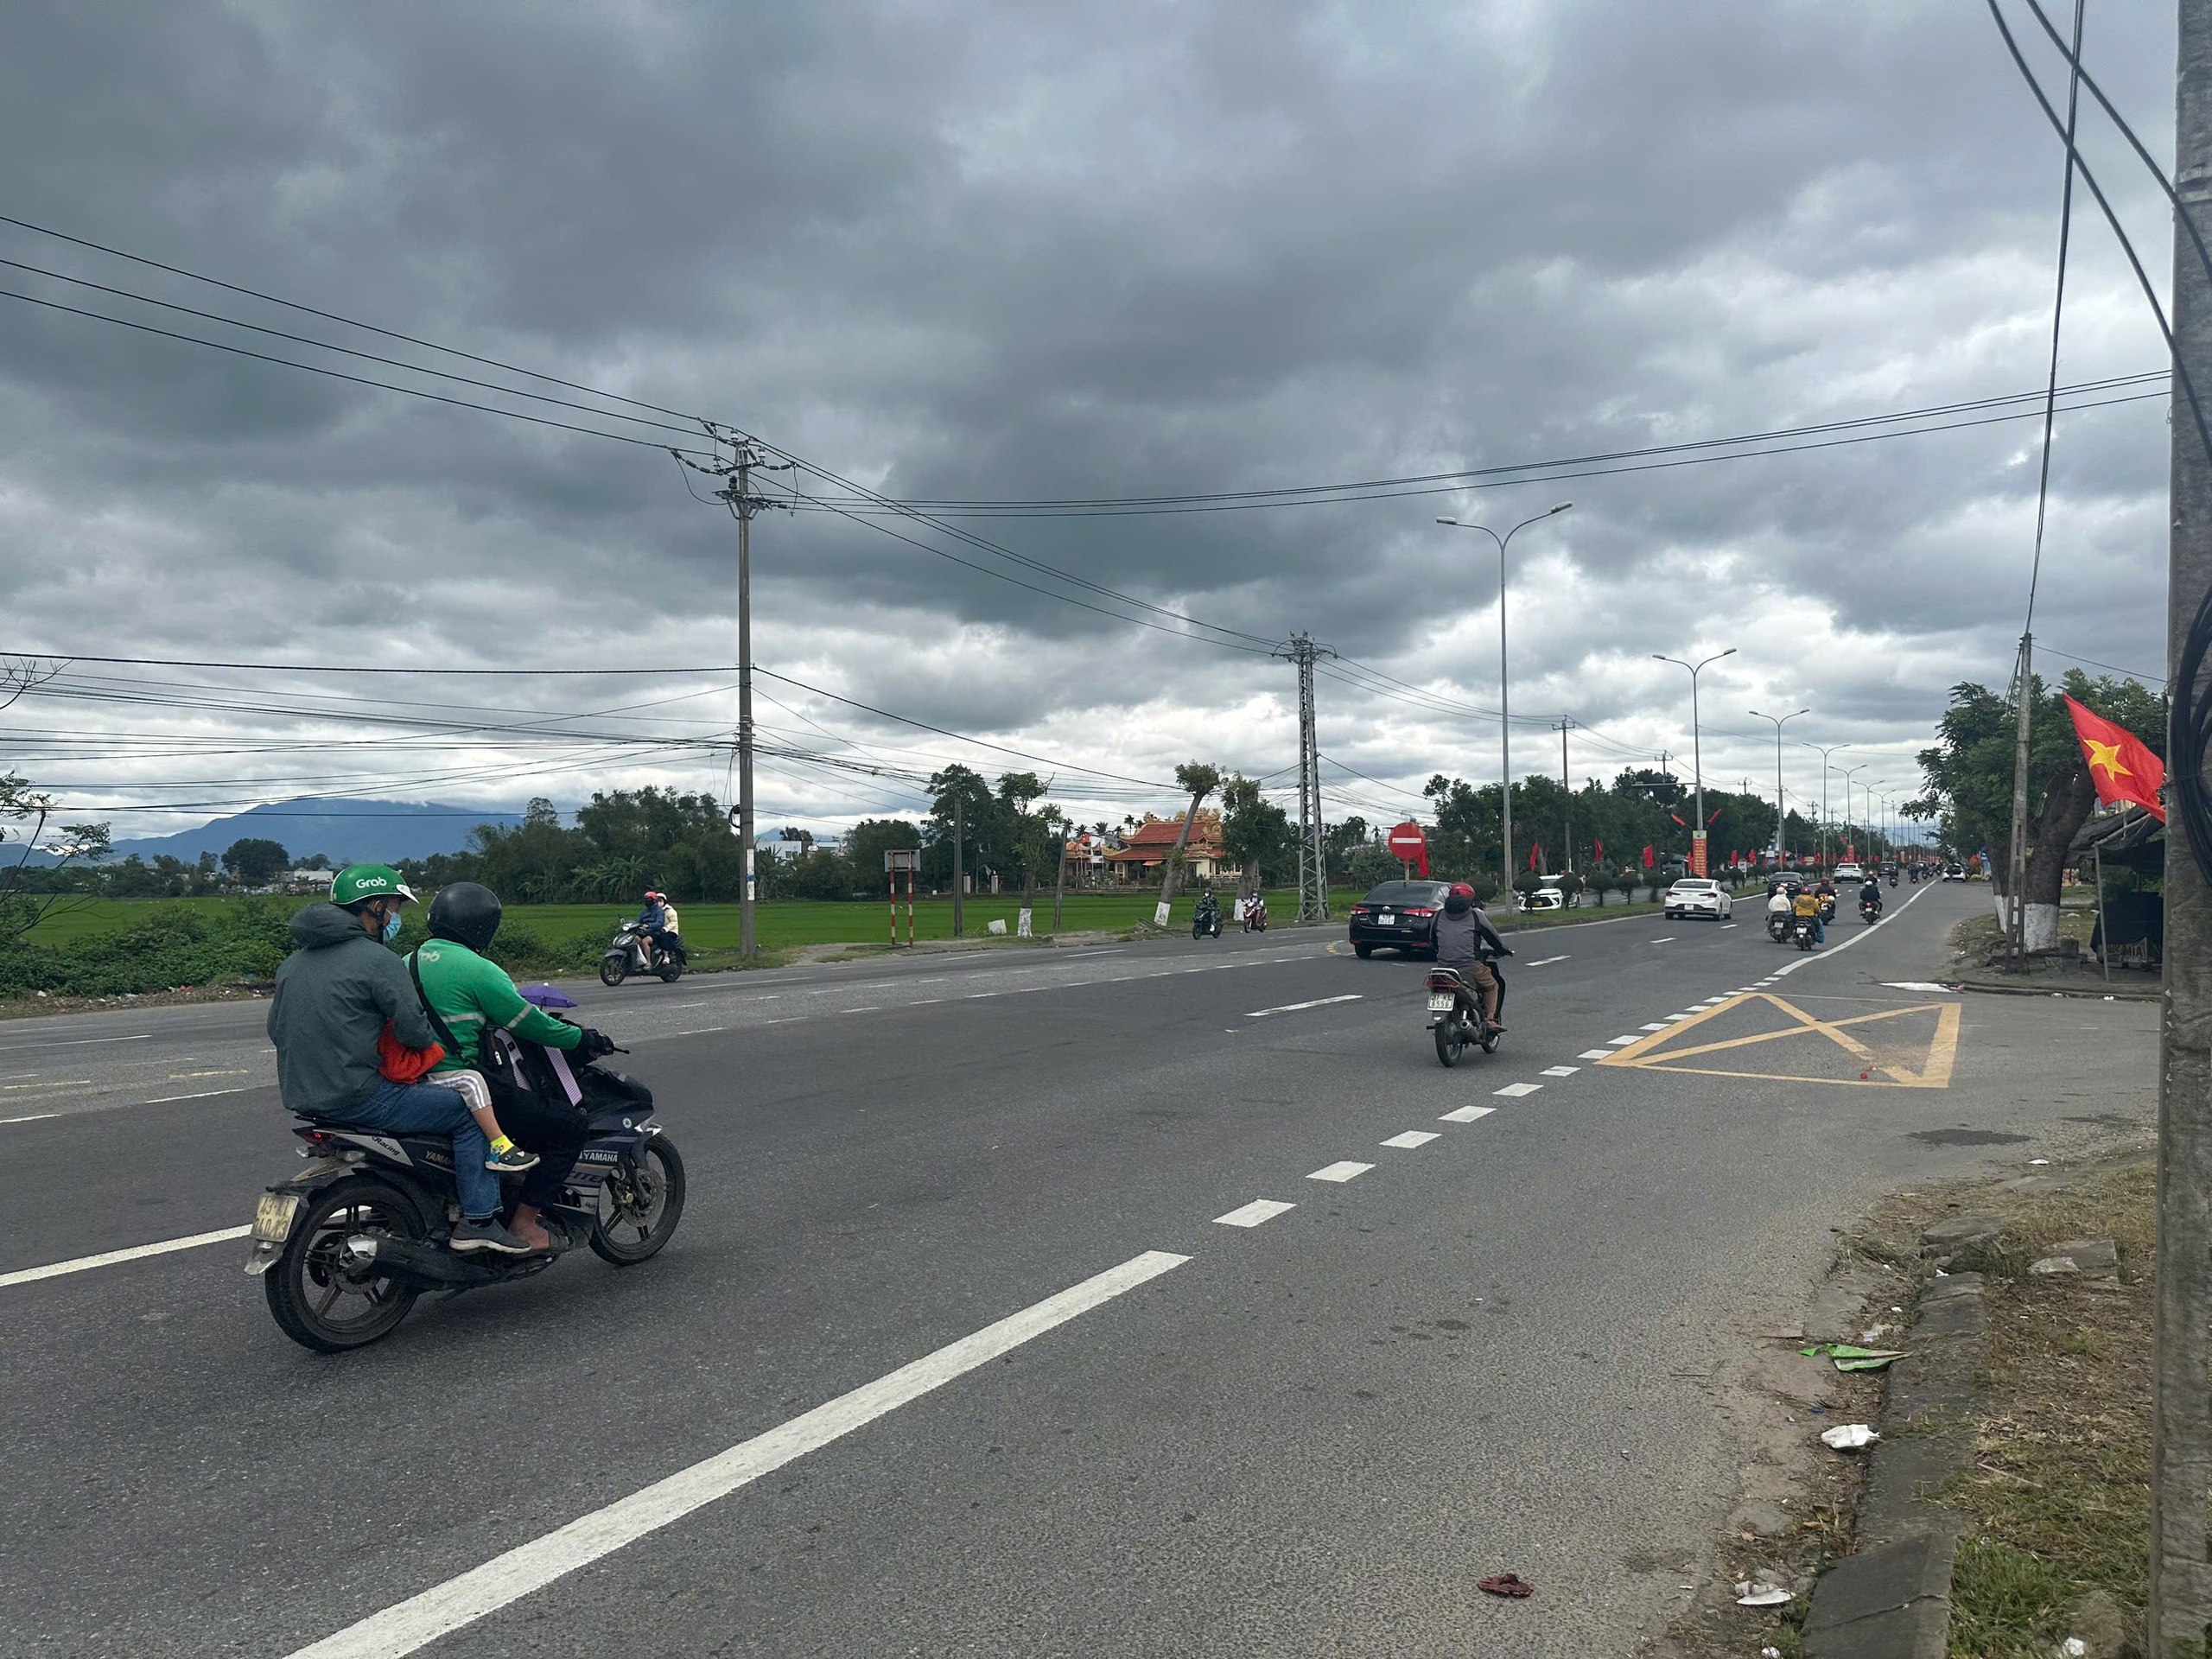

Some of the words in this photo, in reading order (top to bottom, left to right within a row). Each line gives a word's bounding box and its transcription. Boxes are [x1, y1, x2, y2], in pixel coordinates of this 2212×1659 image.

[355, 876, 387, 889] Grab
[373, 1136, 401, 1156] Racing
[582, 1152, 619, 1163] YAMAHA
